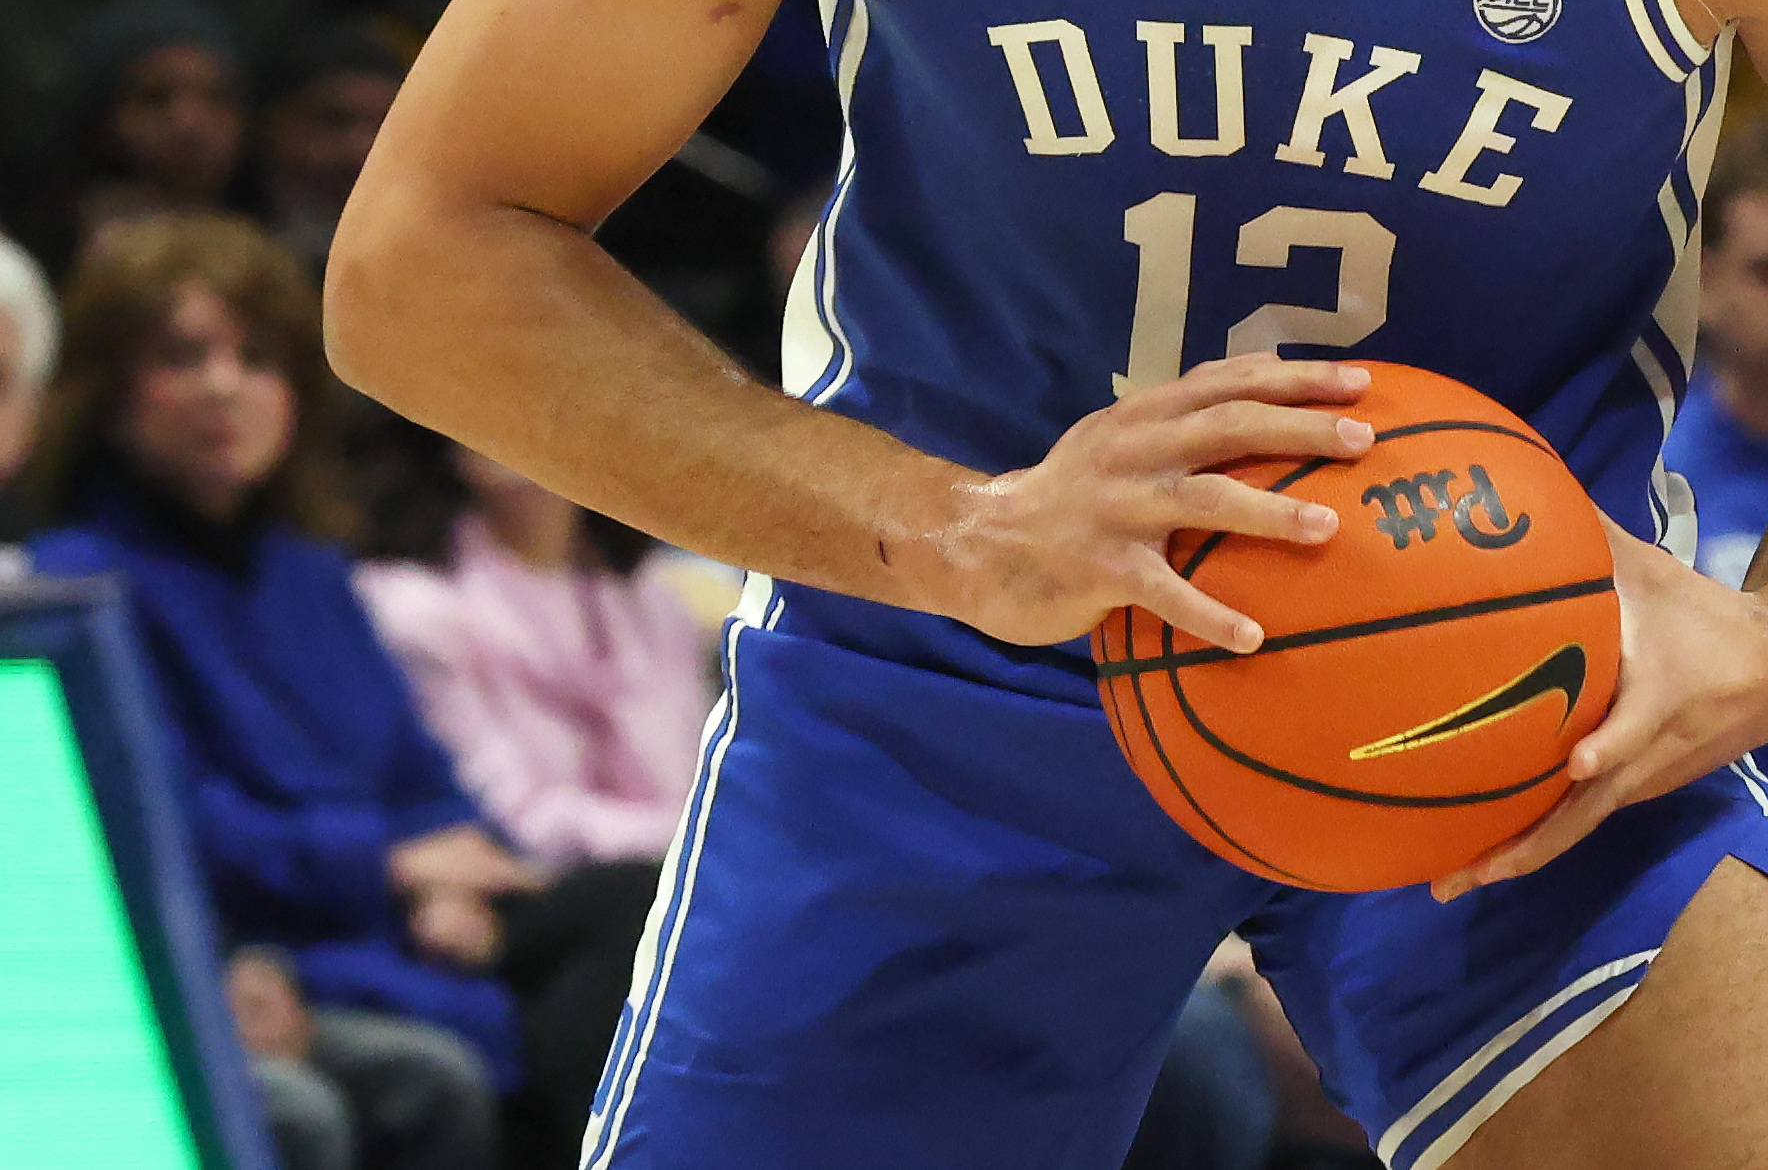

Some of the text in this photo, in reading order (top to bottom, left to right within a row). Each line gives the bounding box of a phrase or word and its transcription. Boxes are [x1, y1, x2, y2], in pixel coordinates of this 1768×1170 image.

[987, 19, 1573, 207] DUKE
[1111, 191, 1397, 399] 12
[1361, 465, 1531, 549] Pitt
